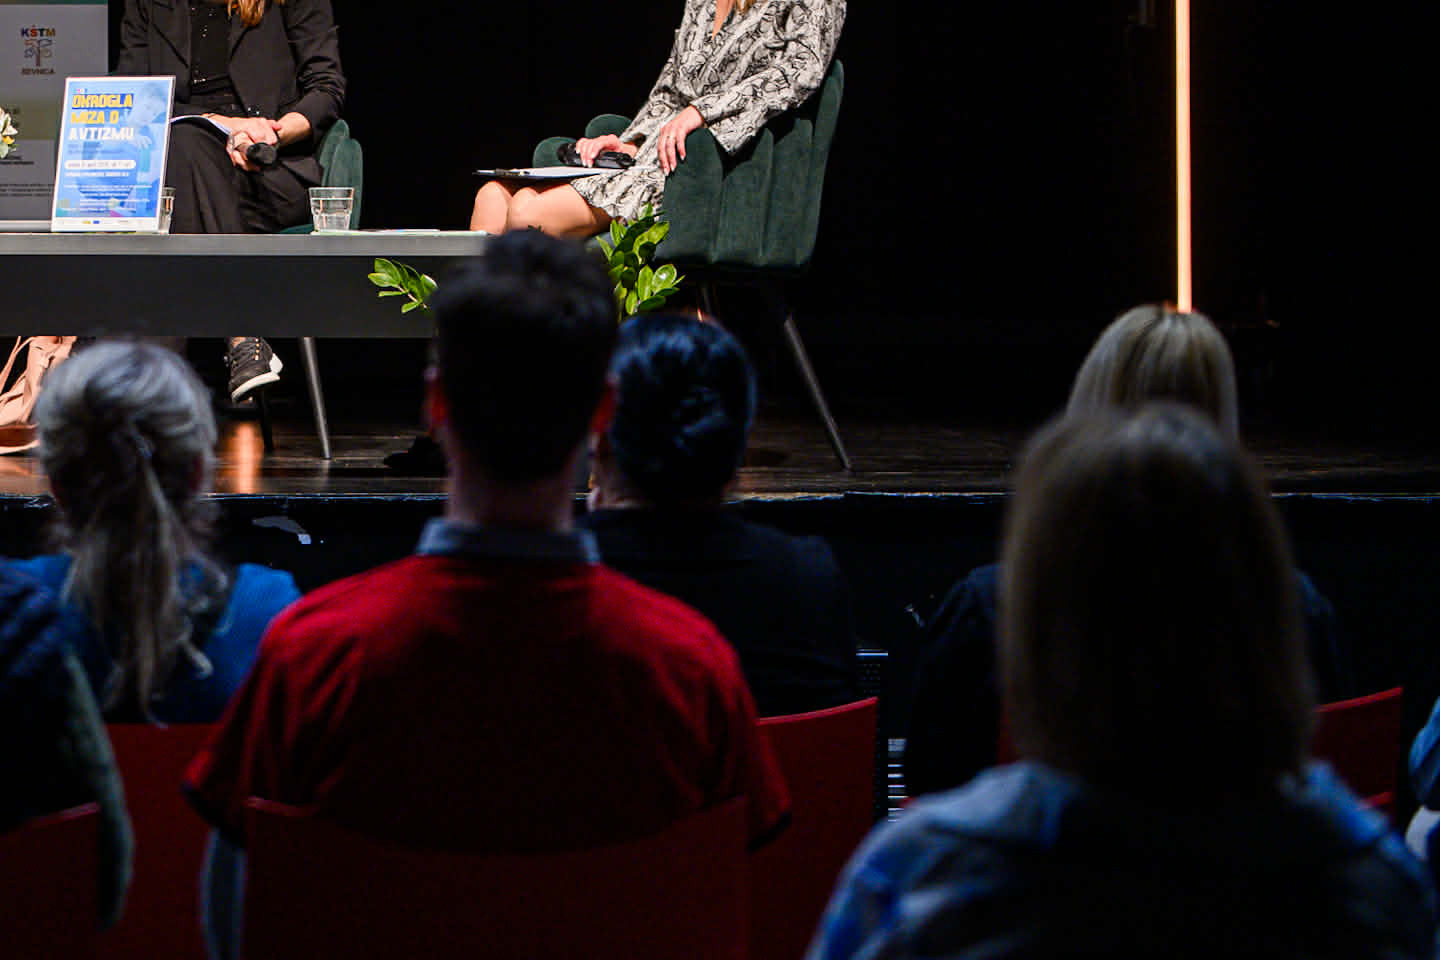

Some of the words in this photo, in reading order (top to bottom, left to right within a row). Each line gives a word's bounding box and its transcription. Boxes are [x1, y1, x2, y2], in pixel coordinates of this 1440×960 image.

[72, 93, 134, 109] OKROGLA
[71, 111, 105, 125] MIZA
[109, 110, 119, 124] O
[68, 127, 134, 141] AVTIZMU
